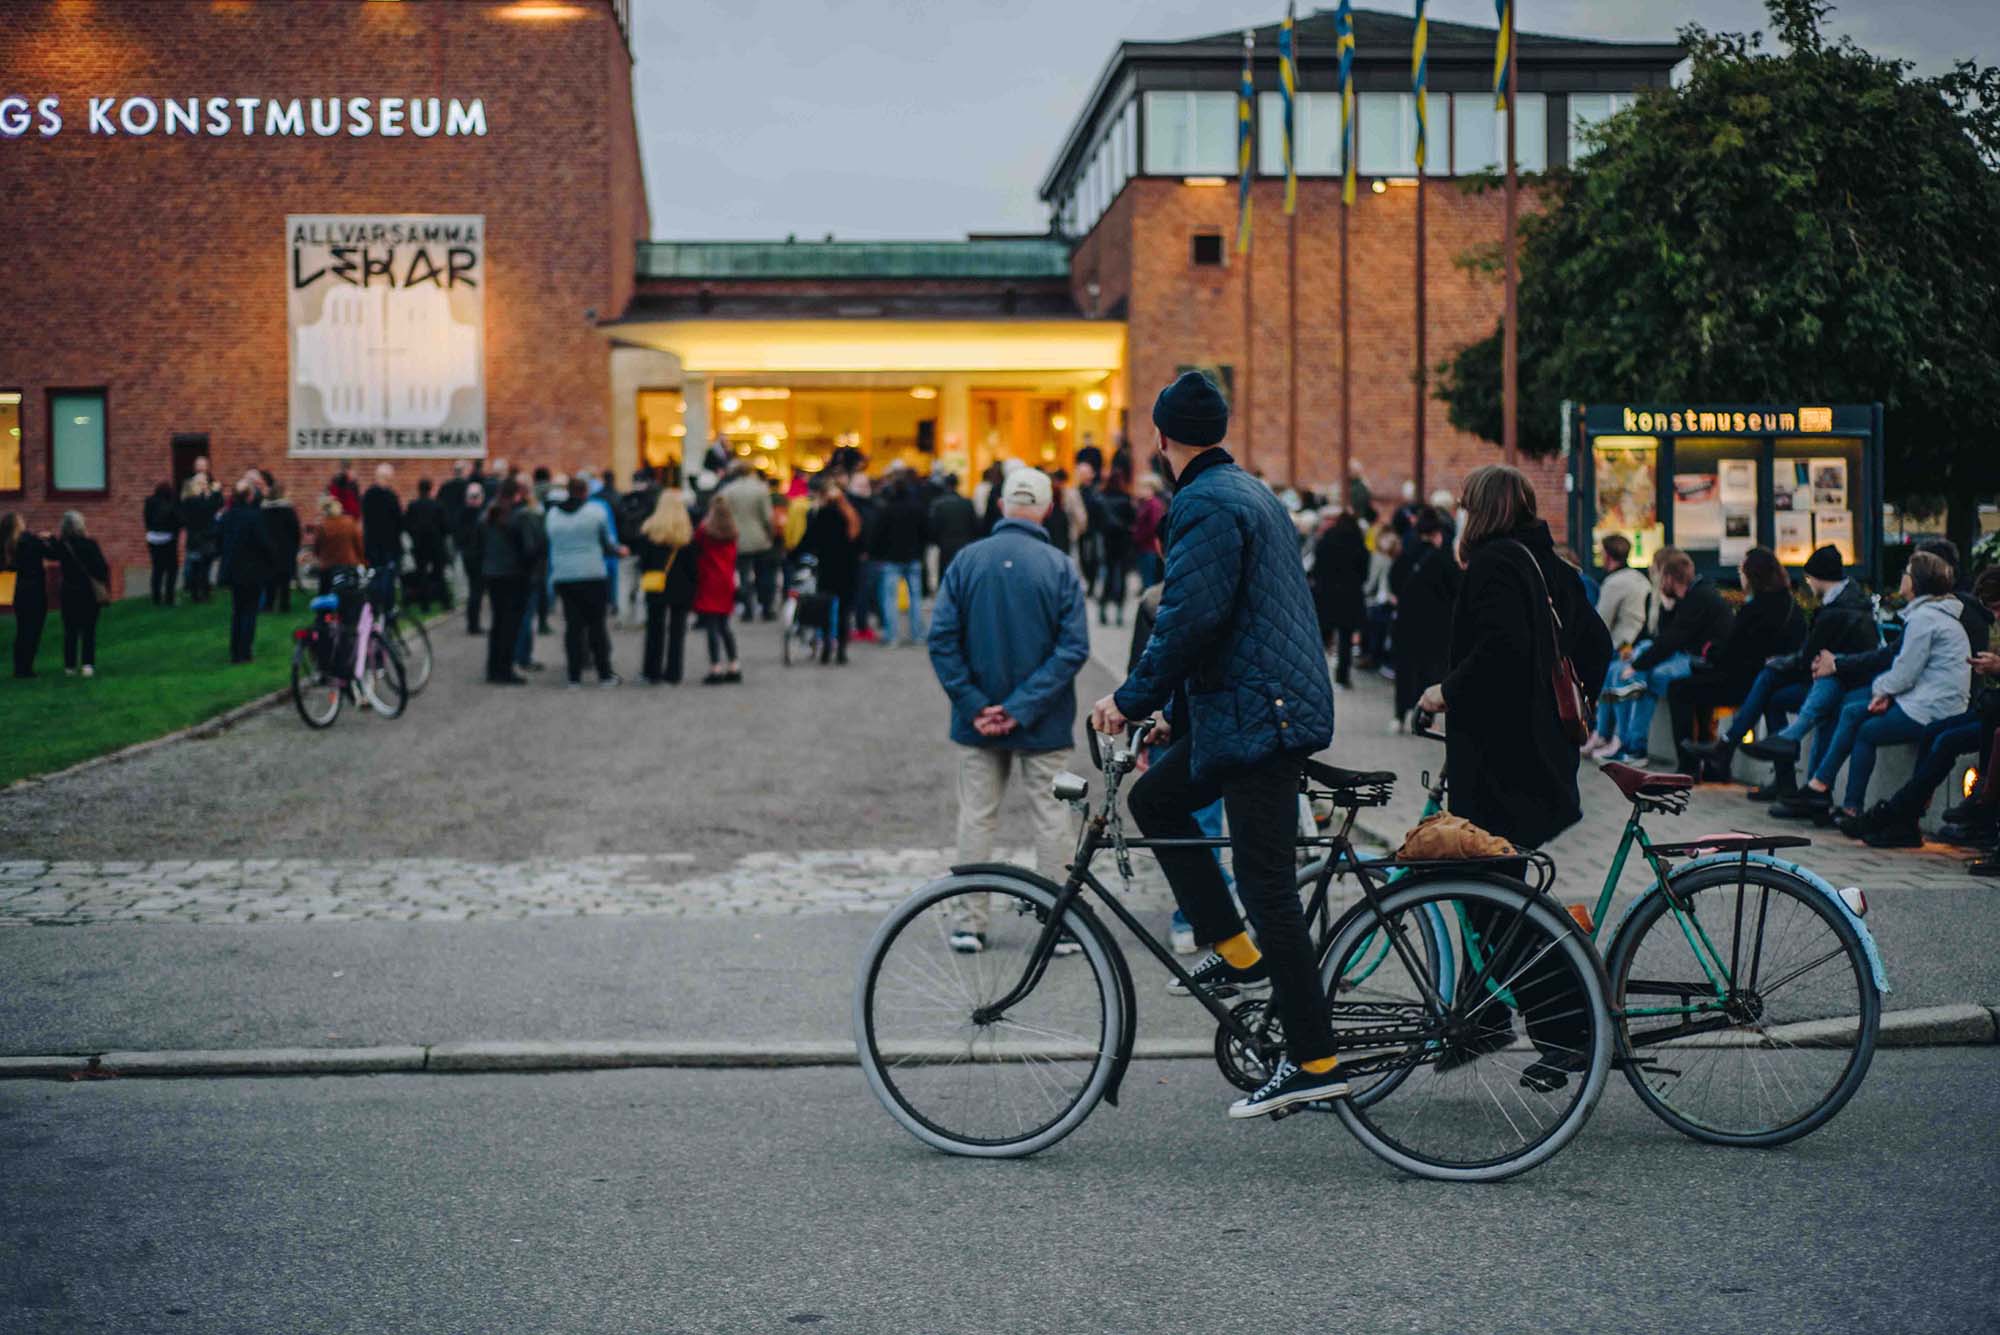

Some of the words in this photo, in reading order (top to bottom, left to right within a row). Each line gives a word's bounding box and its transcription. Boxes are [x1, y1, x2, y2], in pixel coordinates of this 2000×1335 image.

[88, 97, 488, 137] KONSTMUSEUM
[294, 223, 477, 245] ALLVARSAMMA
[294, 247, 477, 289] LEKAR
[1623, 407, 1796, 432] konstmuseum
[297, 429, 376, 447] STEFAN
[384, 429, 481, 447] TELEMAN
